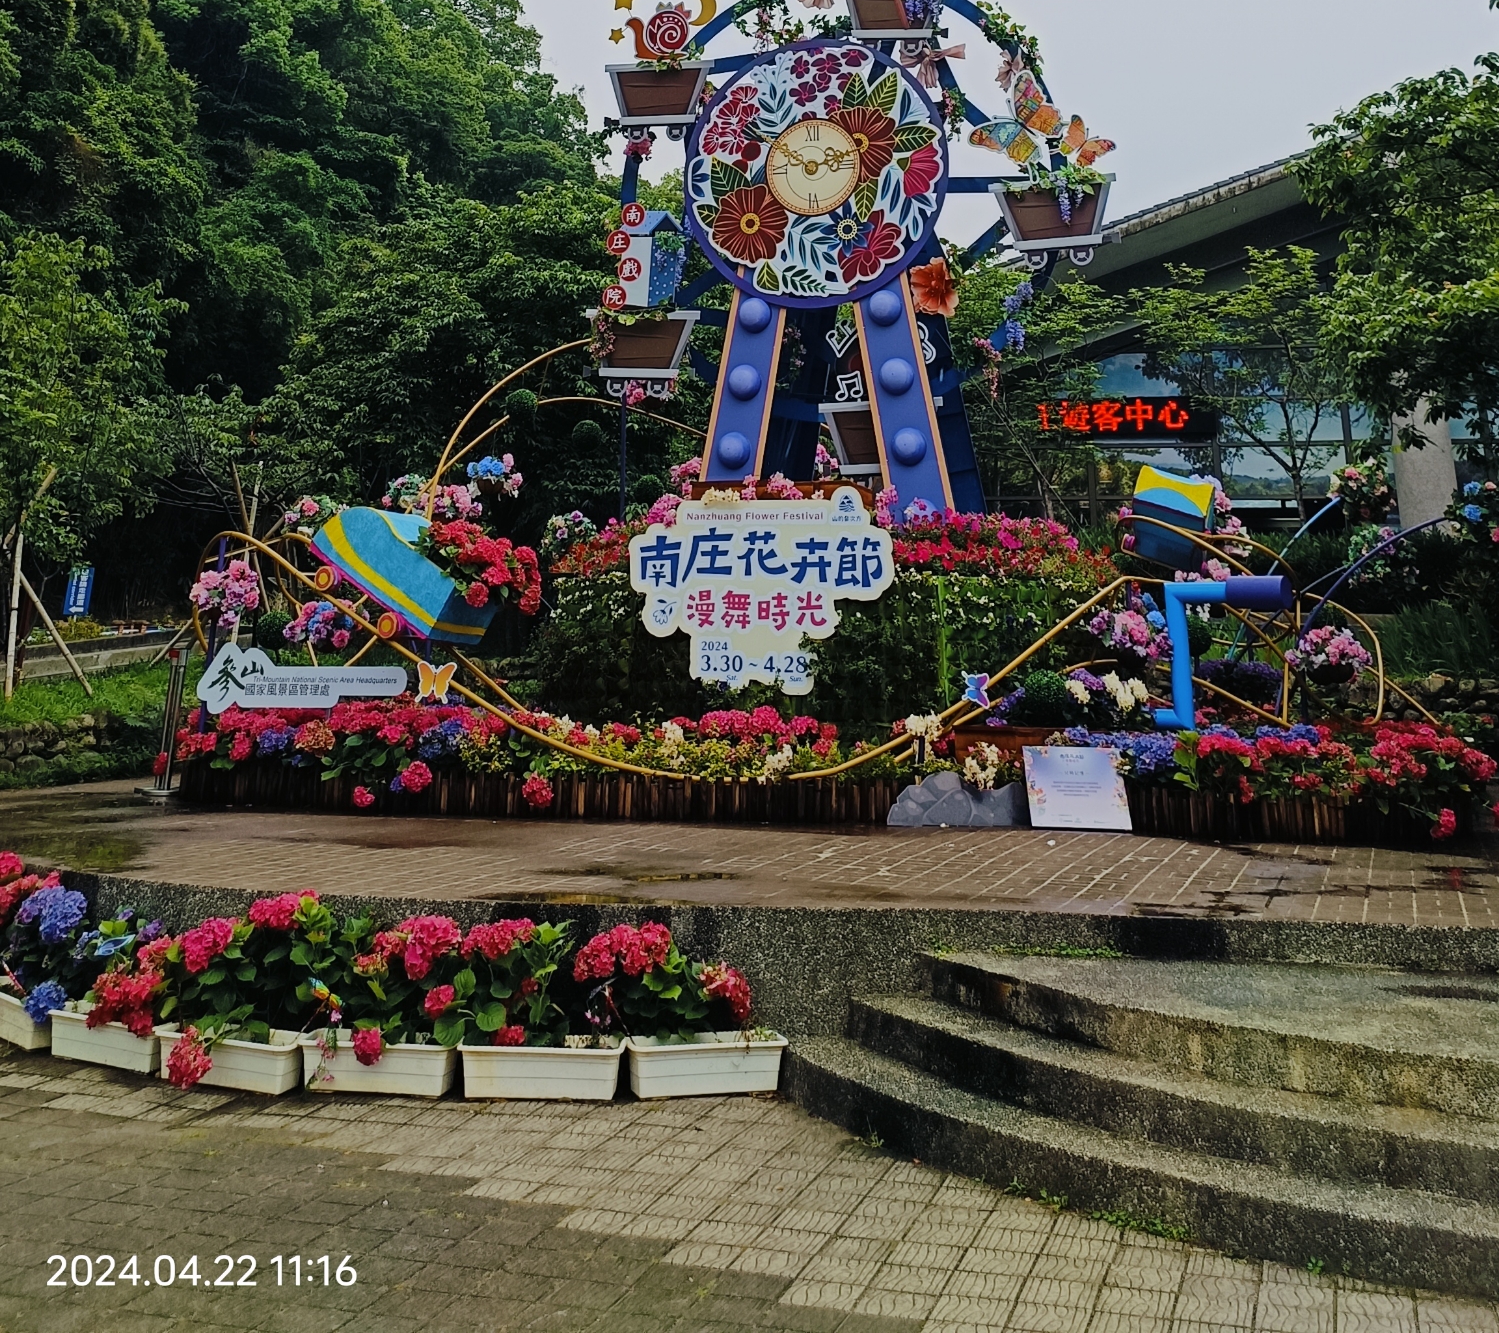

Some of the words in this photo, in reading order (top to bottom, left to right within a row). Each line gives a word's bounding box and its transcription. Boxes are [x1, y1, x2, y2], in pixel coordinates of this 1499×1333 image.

[686, 512, 742, 522] Nanzhuang
[745, 511, 780, 521] Flower
[783, 511, 824, 521] Festival
[639, 527, 883, 588] 南庄花卉節
[686, 590, 827, 631] 漫舞時光
[701, 641, 728, 651] 2024
[700, 654, 743, 672] 3.30
[355, 677, 398, 685] Headquarters
[245, 683, 330, 696] 國家風景區管理處
